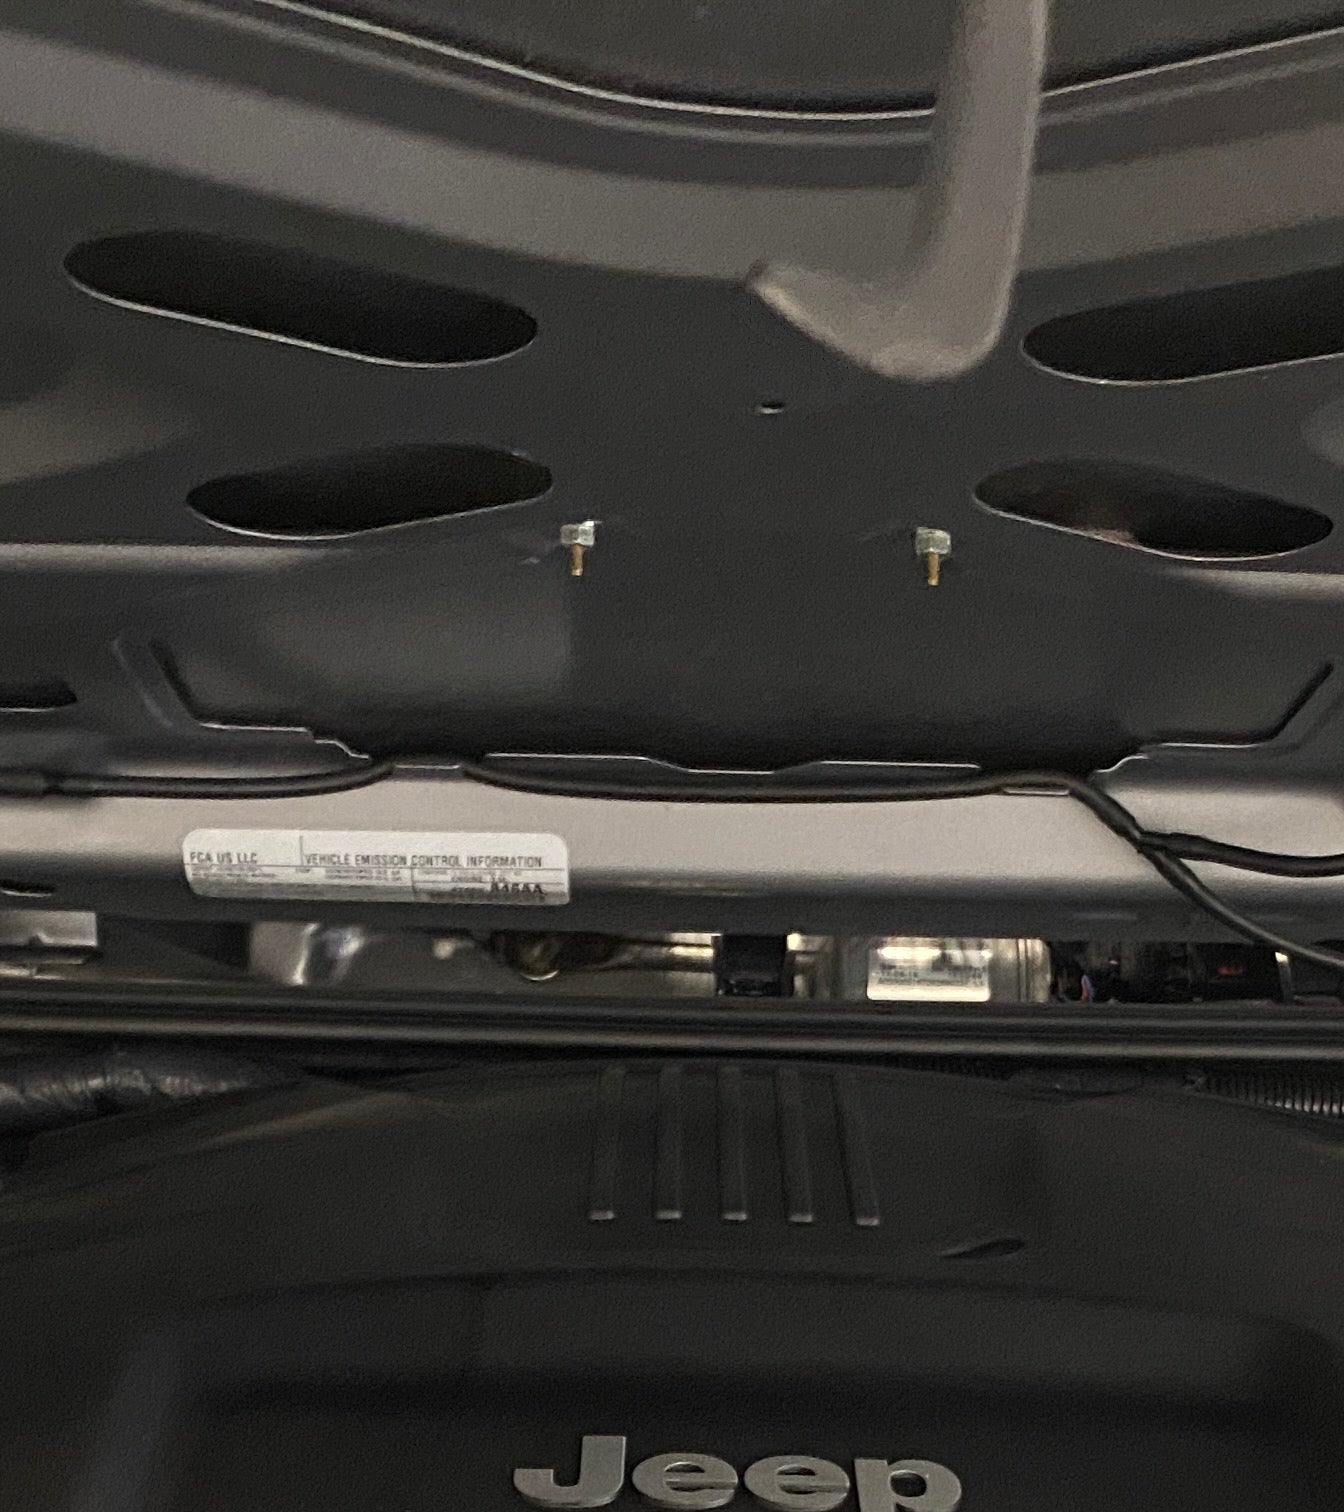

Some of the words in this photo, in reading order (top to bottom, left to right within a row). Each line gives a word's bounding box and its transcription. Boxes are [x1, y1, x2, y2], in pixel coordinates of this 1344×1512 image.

[190, 851, 212, 864] FCA
[217, 851, 233, 864] US
[237, 852, 257, 864] LLC
[306, 853, 351, 866] VEHICLE
[355, 854, 407, 866] EMISSION
[411, 854, 460, 867] CONTROL
[466, 855, 543, 868] INFORMATION
